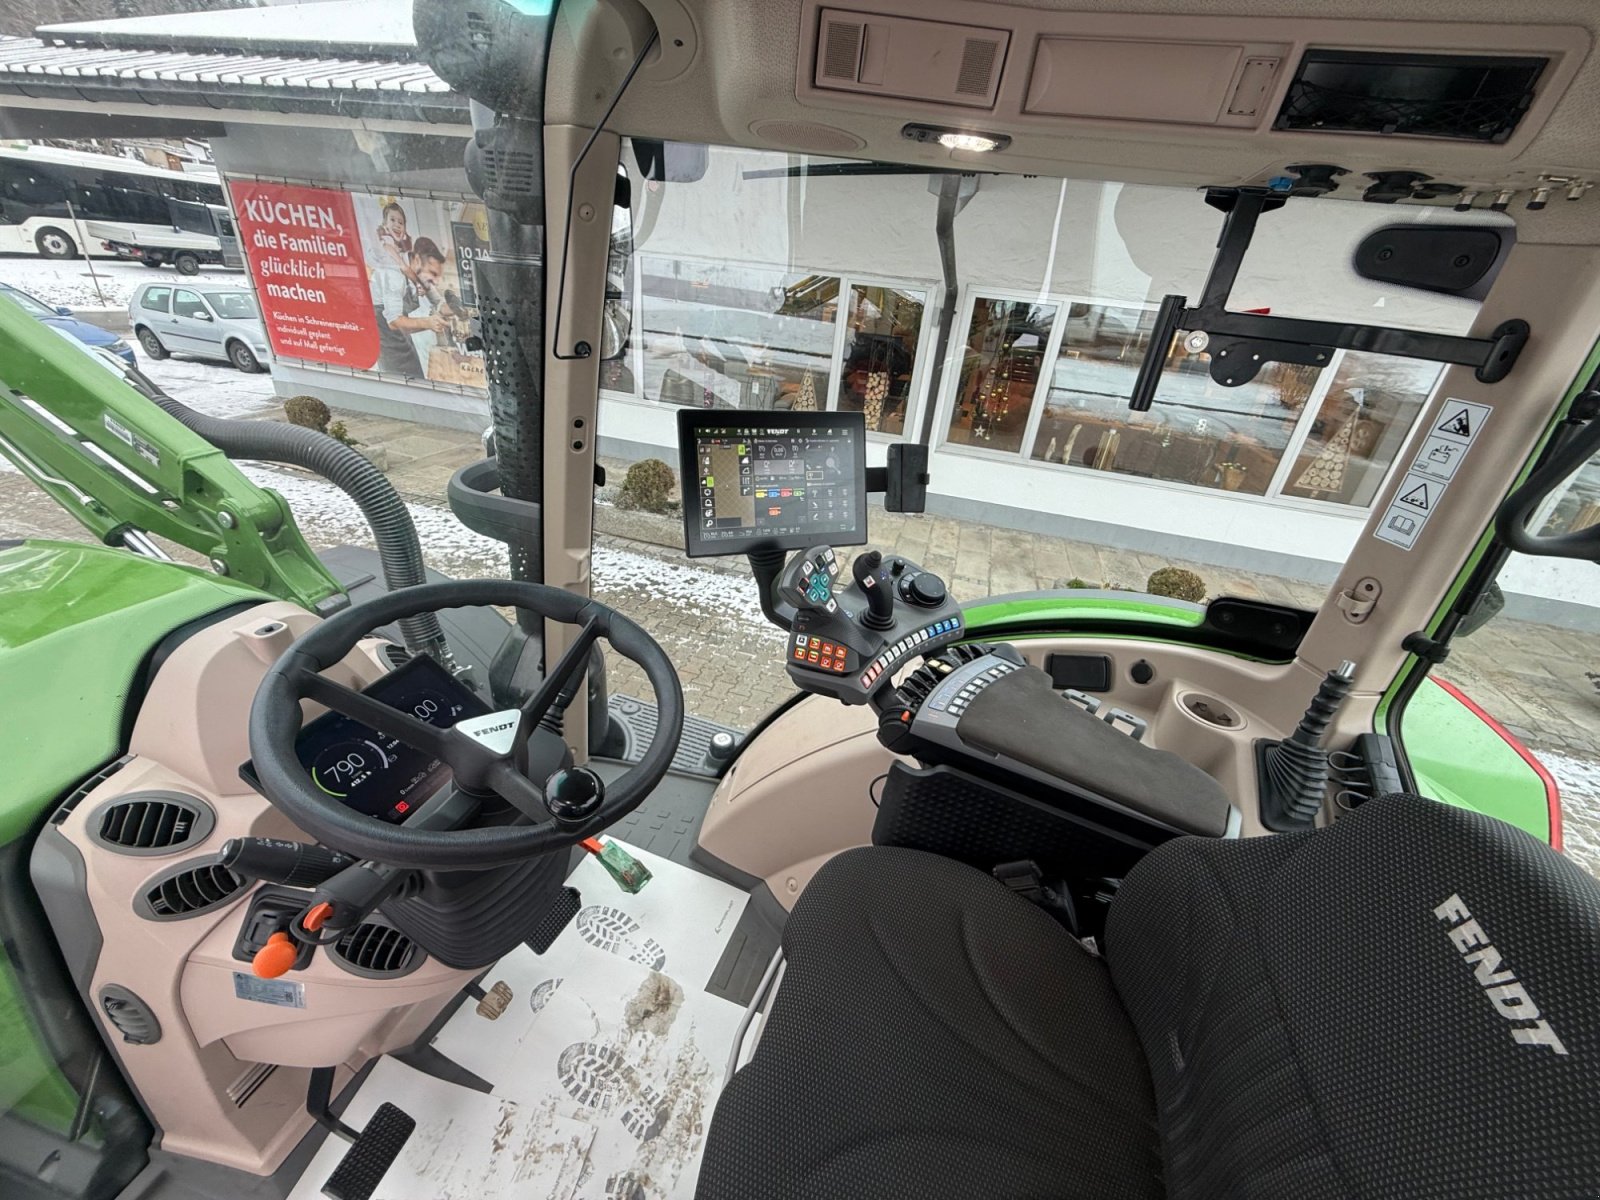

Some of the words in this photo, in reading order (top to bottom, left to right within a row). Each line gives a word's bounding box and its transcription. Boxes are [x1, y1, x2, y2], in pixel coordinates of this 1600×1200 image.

[244, 194, 343, 237] KÜCHEN,
[253, 229, 278, 249] die
[279, 232, 348, 257] Familien
[459, 246, 473, 259] 10
[260, 256, 326, 280] glücklich
[266, 282, 327, 304] machen
[272, 311, 297, 323] Küchen
[297, 315, 304, 324] in
[305, 315, 360, 332] Schreinerqualität
[276, 324, 307, 336] individuell
[308, 330, 331, 340] geplant
[293, 339, 303, 347] auf
[303, 340, 318, 350] Maß
[473, 721, 515, 737] FENDT
[323, 753, 365, 783] 790
[1433, 893, 1570, 1055] FENDT
